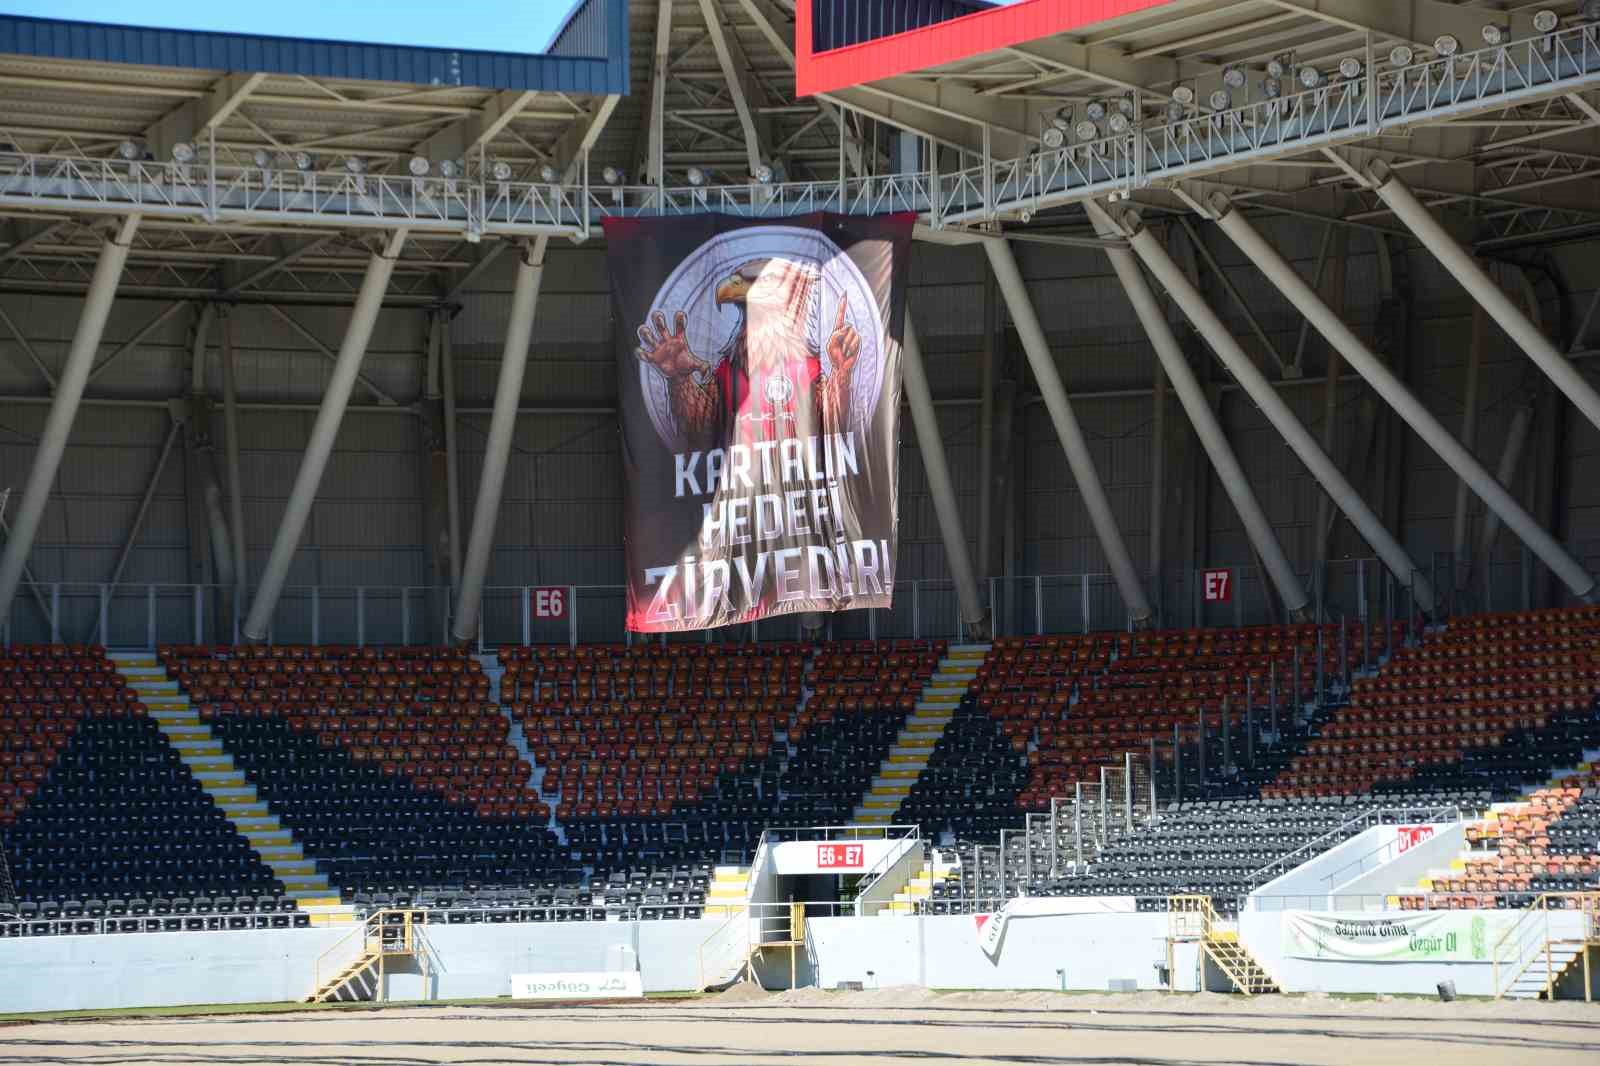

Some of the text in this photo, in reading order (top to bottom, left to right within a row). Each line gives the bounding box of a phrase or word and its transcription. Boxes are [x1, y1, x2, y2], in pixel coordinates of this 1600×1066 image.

[674, 431, 860, 498] KARTALIN
[702, 479, 845, 550] HEDEFİ
[536, 590, 562, 617] E6
[644, 536, 892, 624] ZİRVEDİR!
[1205, 572, 1228, 600] E7
[819, 846, 836, 865] E6
[845, 846, 862, 865] E7
